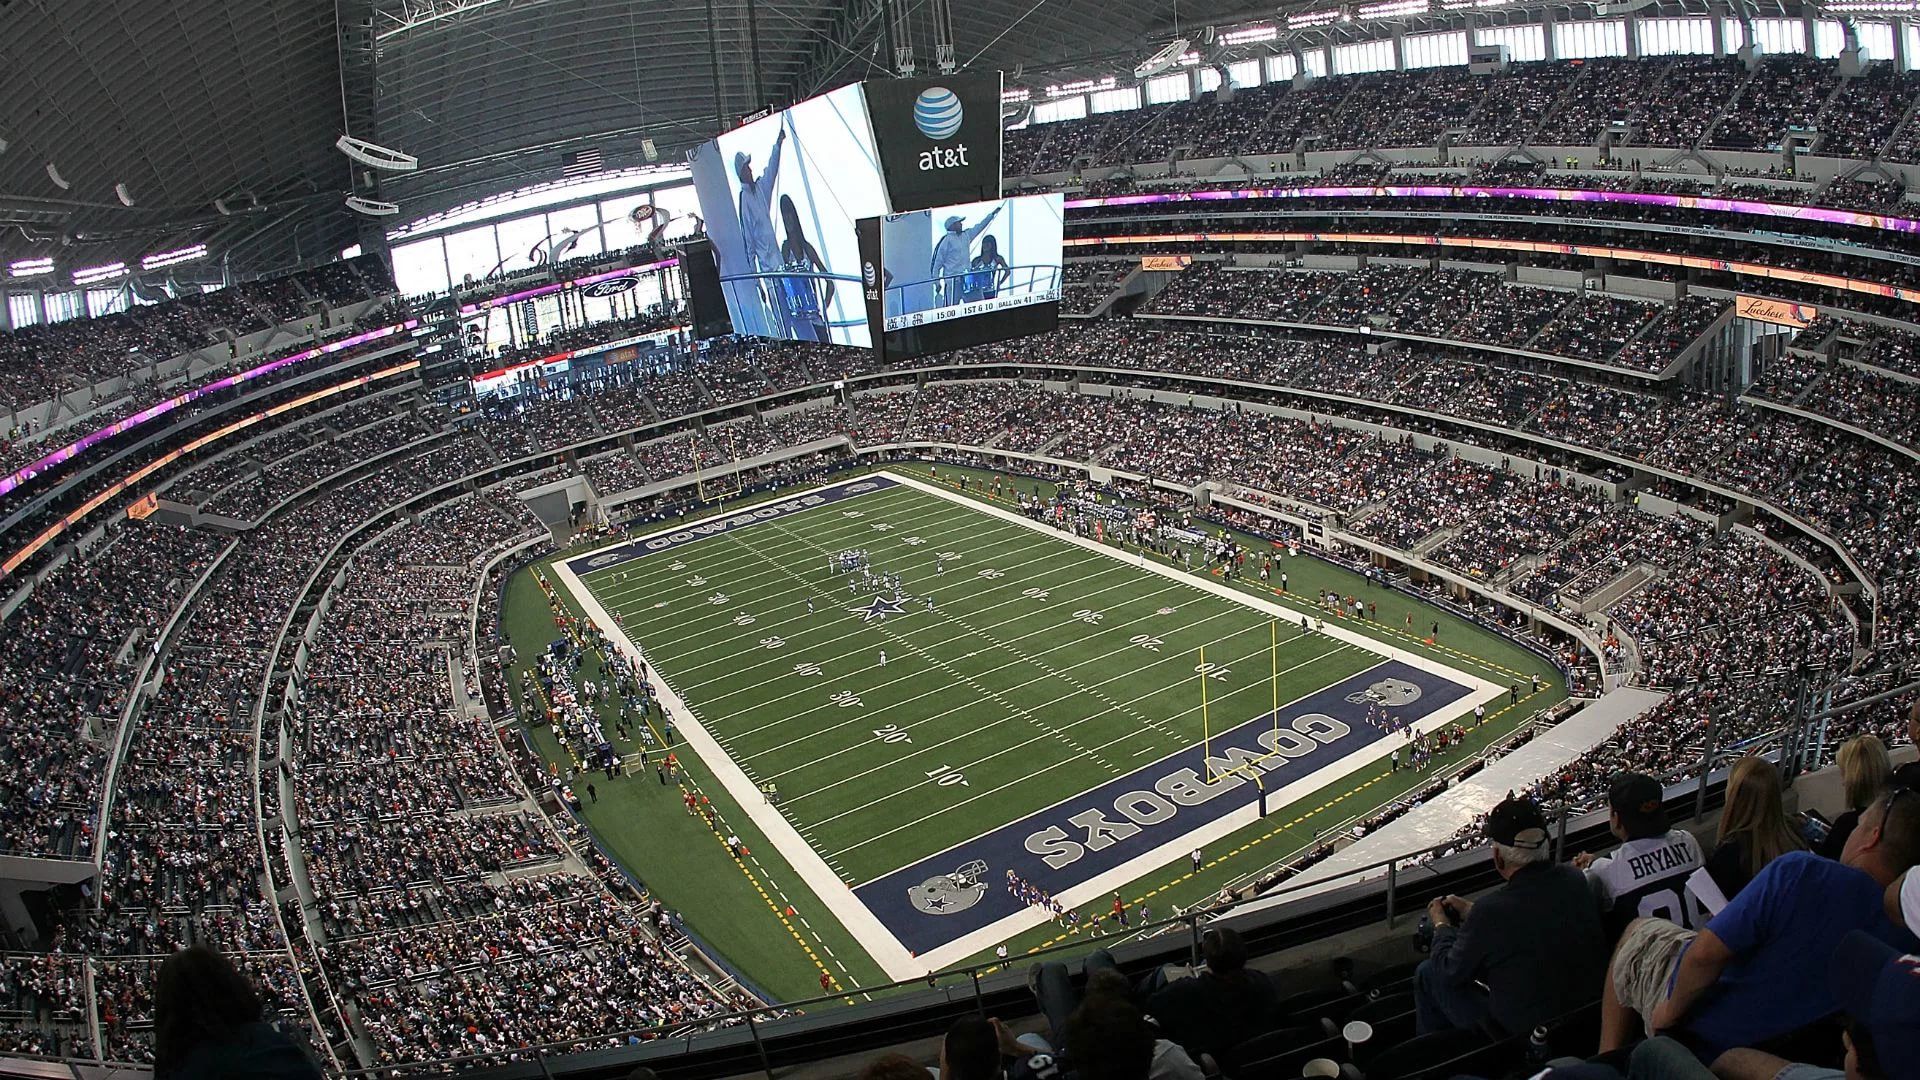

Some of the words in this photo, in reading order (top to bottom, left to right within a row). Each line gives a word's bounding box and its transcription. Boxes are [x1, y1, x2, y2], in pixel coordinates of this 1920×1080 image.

[919, 143, 969, 171] at&t
[594, 280, 629, 297] Ford
[936, 309, 956, 320] 15:00
[964, 306, 977, 314] 1ST
[985, 303, 994, 311] 10
[1740, 299, 1785, 319] Lucchese
[646, 494, 826, 550] COWBOYS
[759, 635, 786, 649] 50
[1129, 635, 1165, 649] 20
[793, 662, 820, 677] 40
[1194, 662, 1232, 679] 10
[829, 690, 861, 708] 30
[873, 724, 908, 744] 20
[924, 764, 964, 786] 10
[1024, 713, 1351, 870] COWBOYS
[1627, 842, 1694, 880] BRYANT
